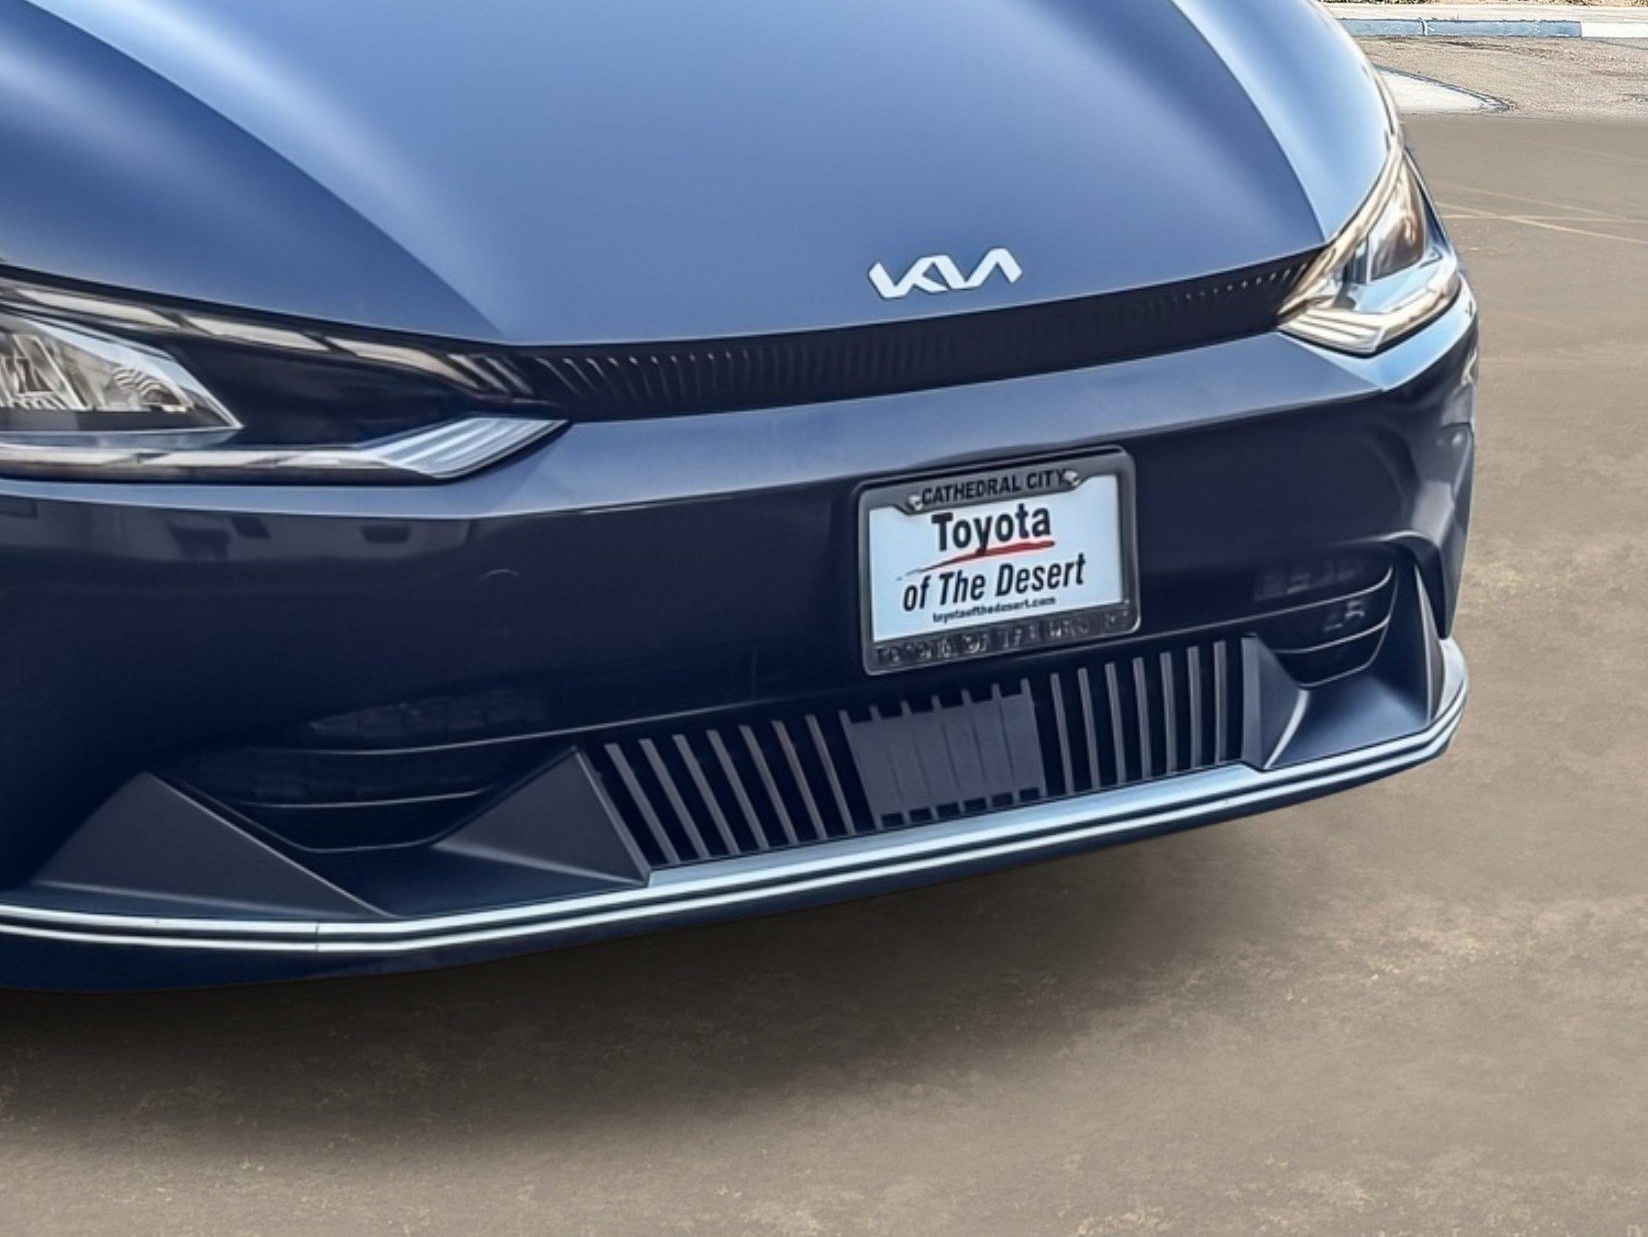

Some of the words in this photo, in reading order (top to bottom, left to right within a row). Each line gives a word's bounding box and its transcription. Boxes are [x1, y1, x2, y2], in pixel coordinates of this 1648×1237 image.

[868, 247, 1023, 298] KIA
[922, 476, 1021, 506] CATHEDRAL
[1026, 468, 1066, 489] CITY
[931, 503, 1051, 556] Toyota
[903, 576, 930, 612] of
[939, 569, 986, 606] The
[995, 552, 1086, 596] Desert
